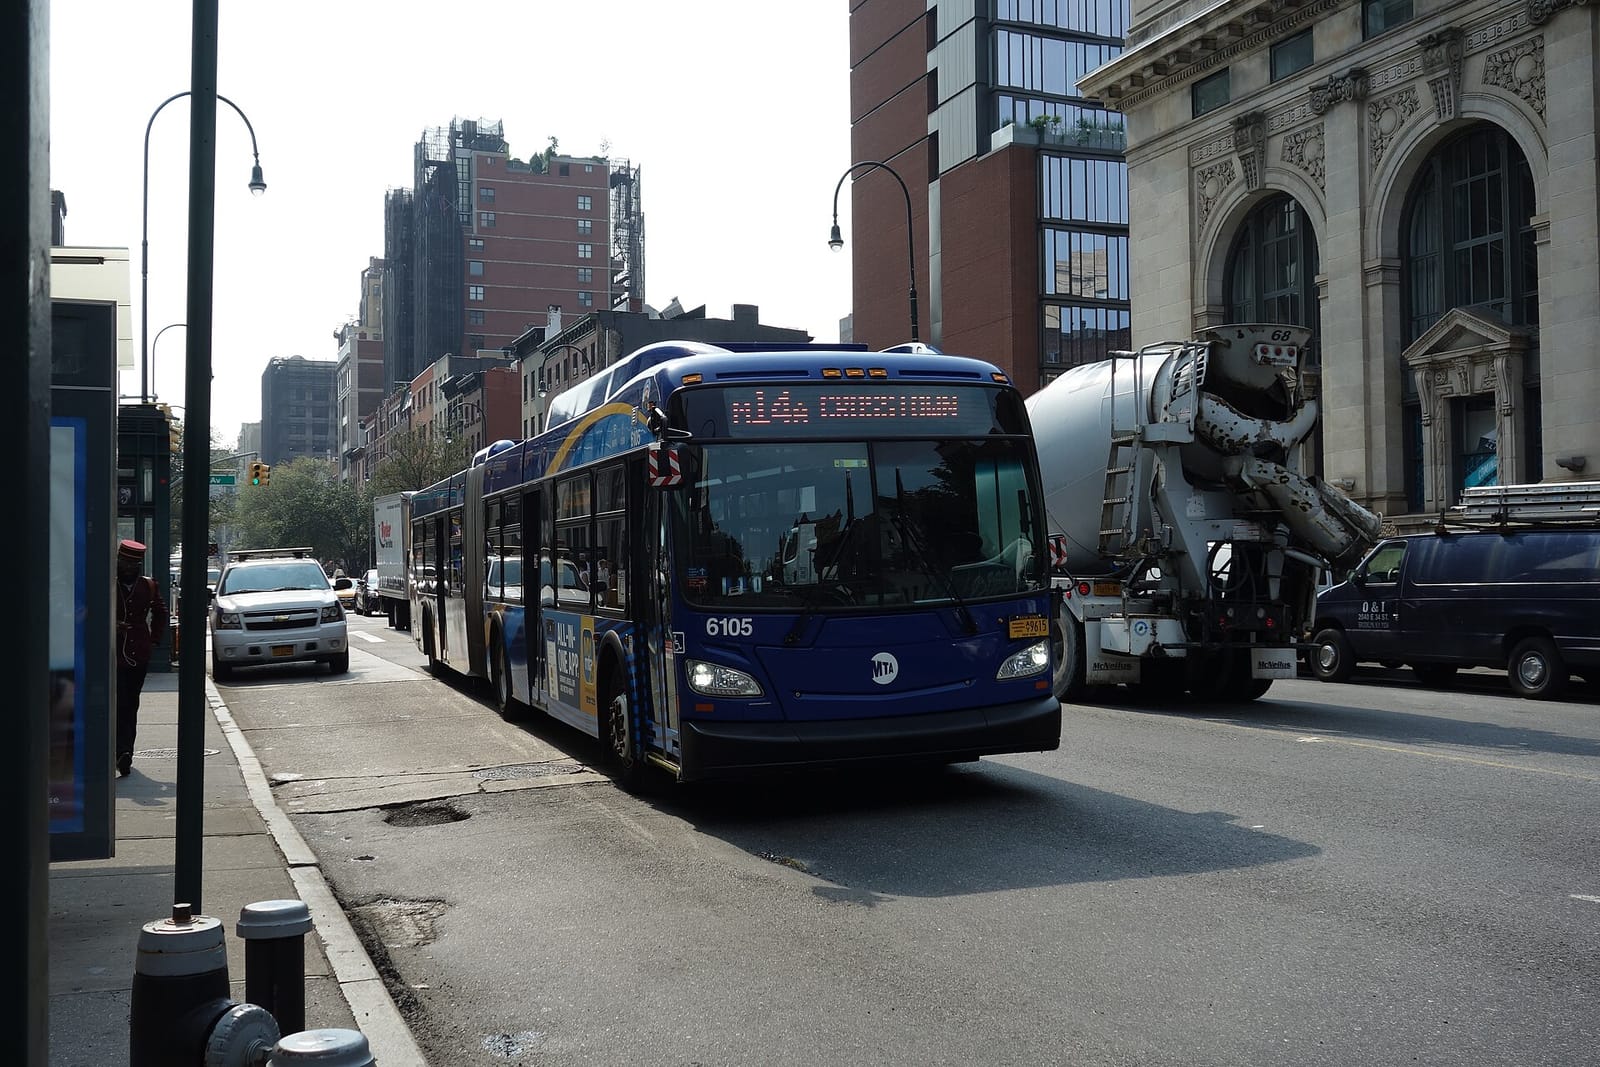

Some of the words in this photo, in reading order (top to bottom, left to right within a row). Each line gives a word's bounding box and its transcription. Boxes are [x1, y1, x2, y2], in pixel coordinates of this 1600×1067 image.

[1271, 329, 1291, 341] 68
[1371, 601, 1379, 613] &
[706, 617, 753, 636] 6105
[871, 658, 895, 679] MTA
